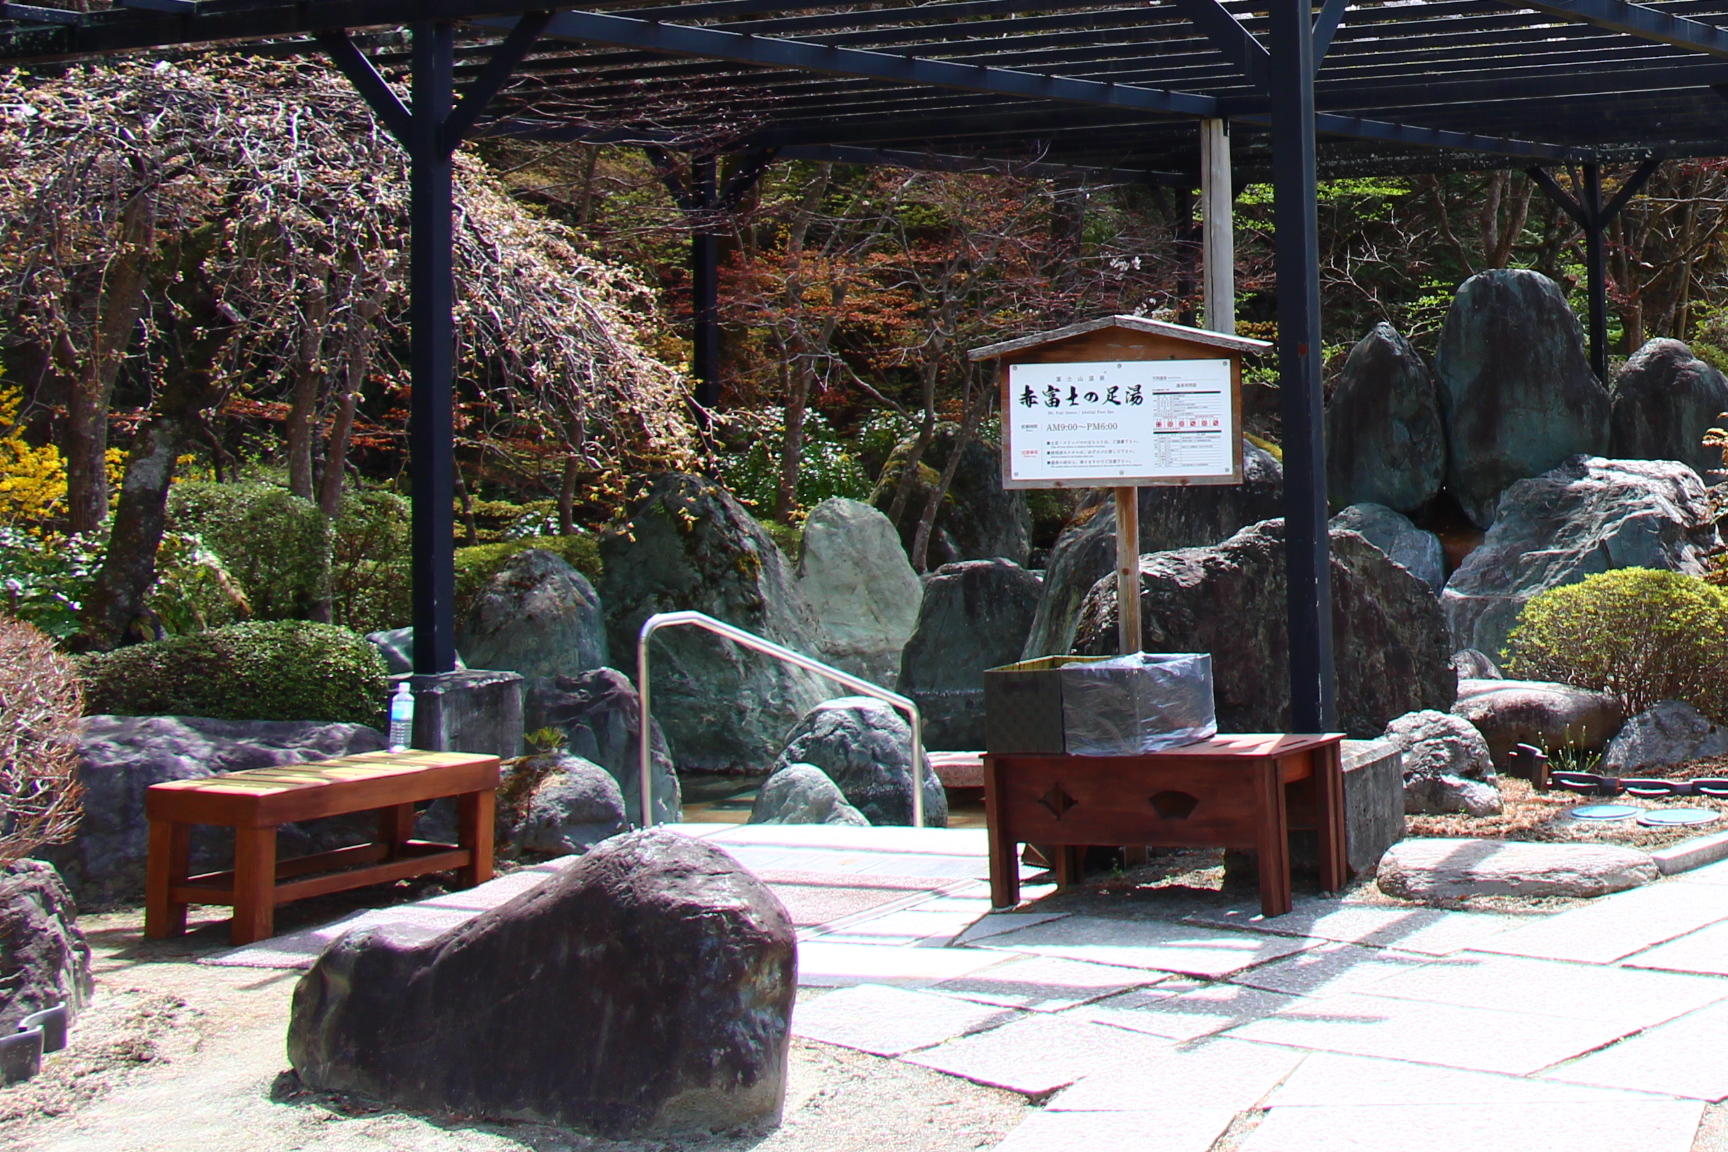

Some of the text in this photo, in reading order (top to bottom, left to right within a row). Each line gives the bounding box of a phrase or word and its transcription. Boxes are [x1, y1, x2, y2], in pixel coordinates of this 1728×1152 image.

[1019, 384, 1144, 408] 赤富士の足湯
